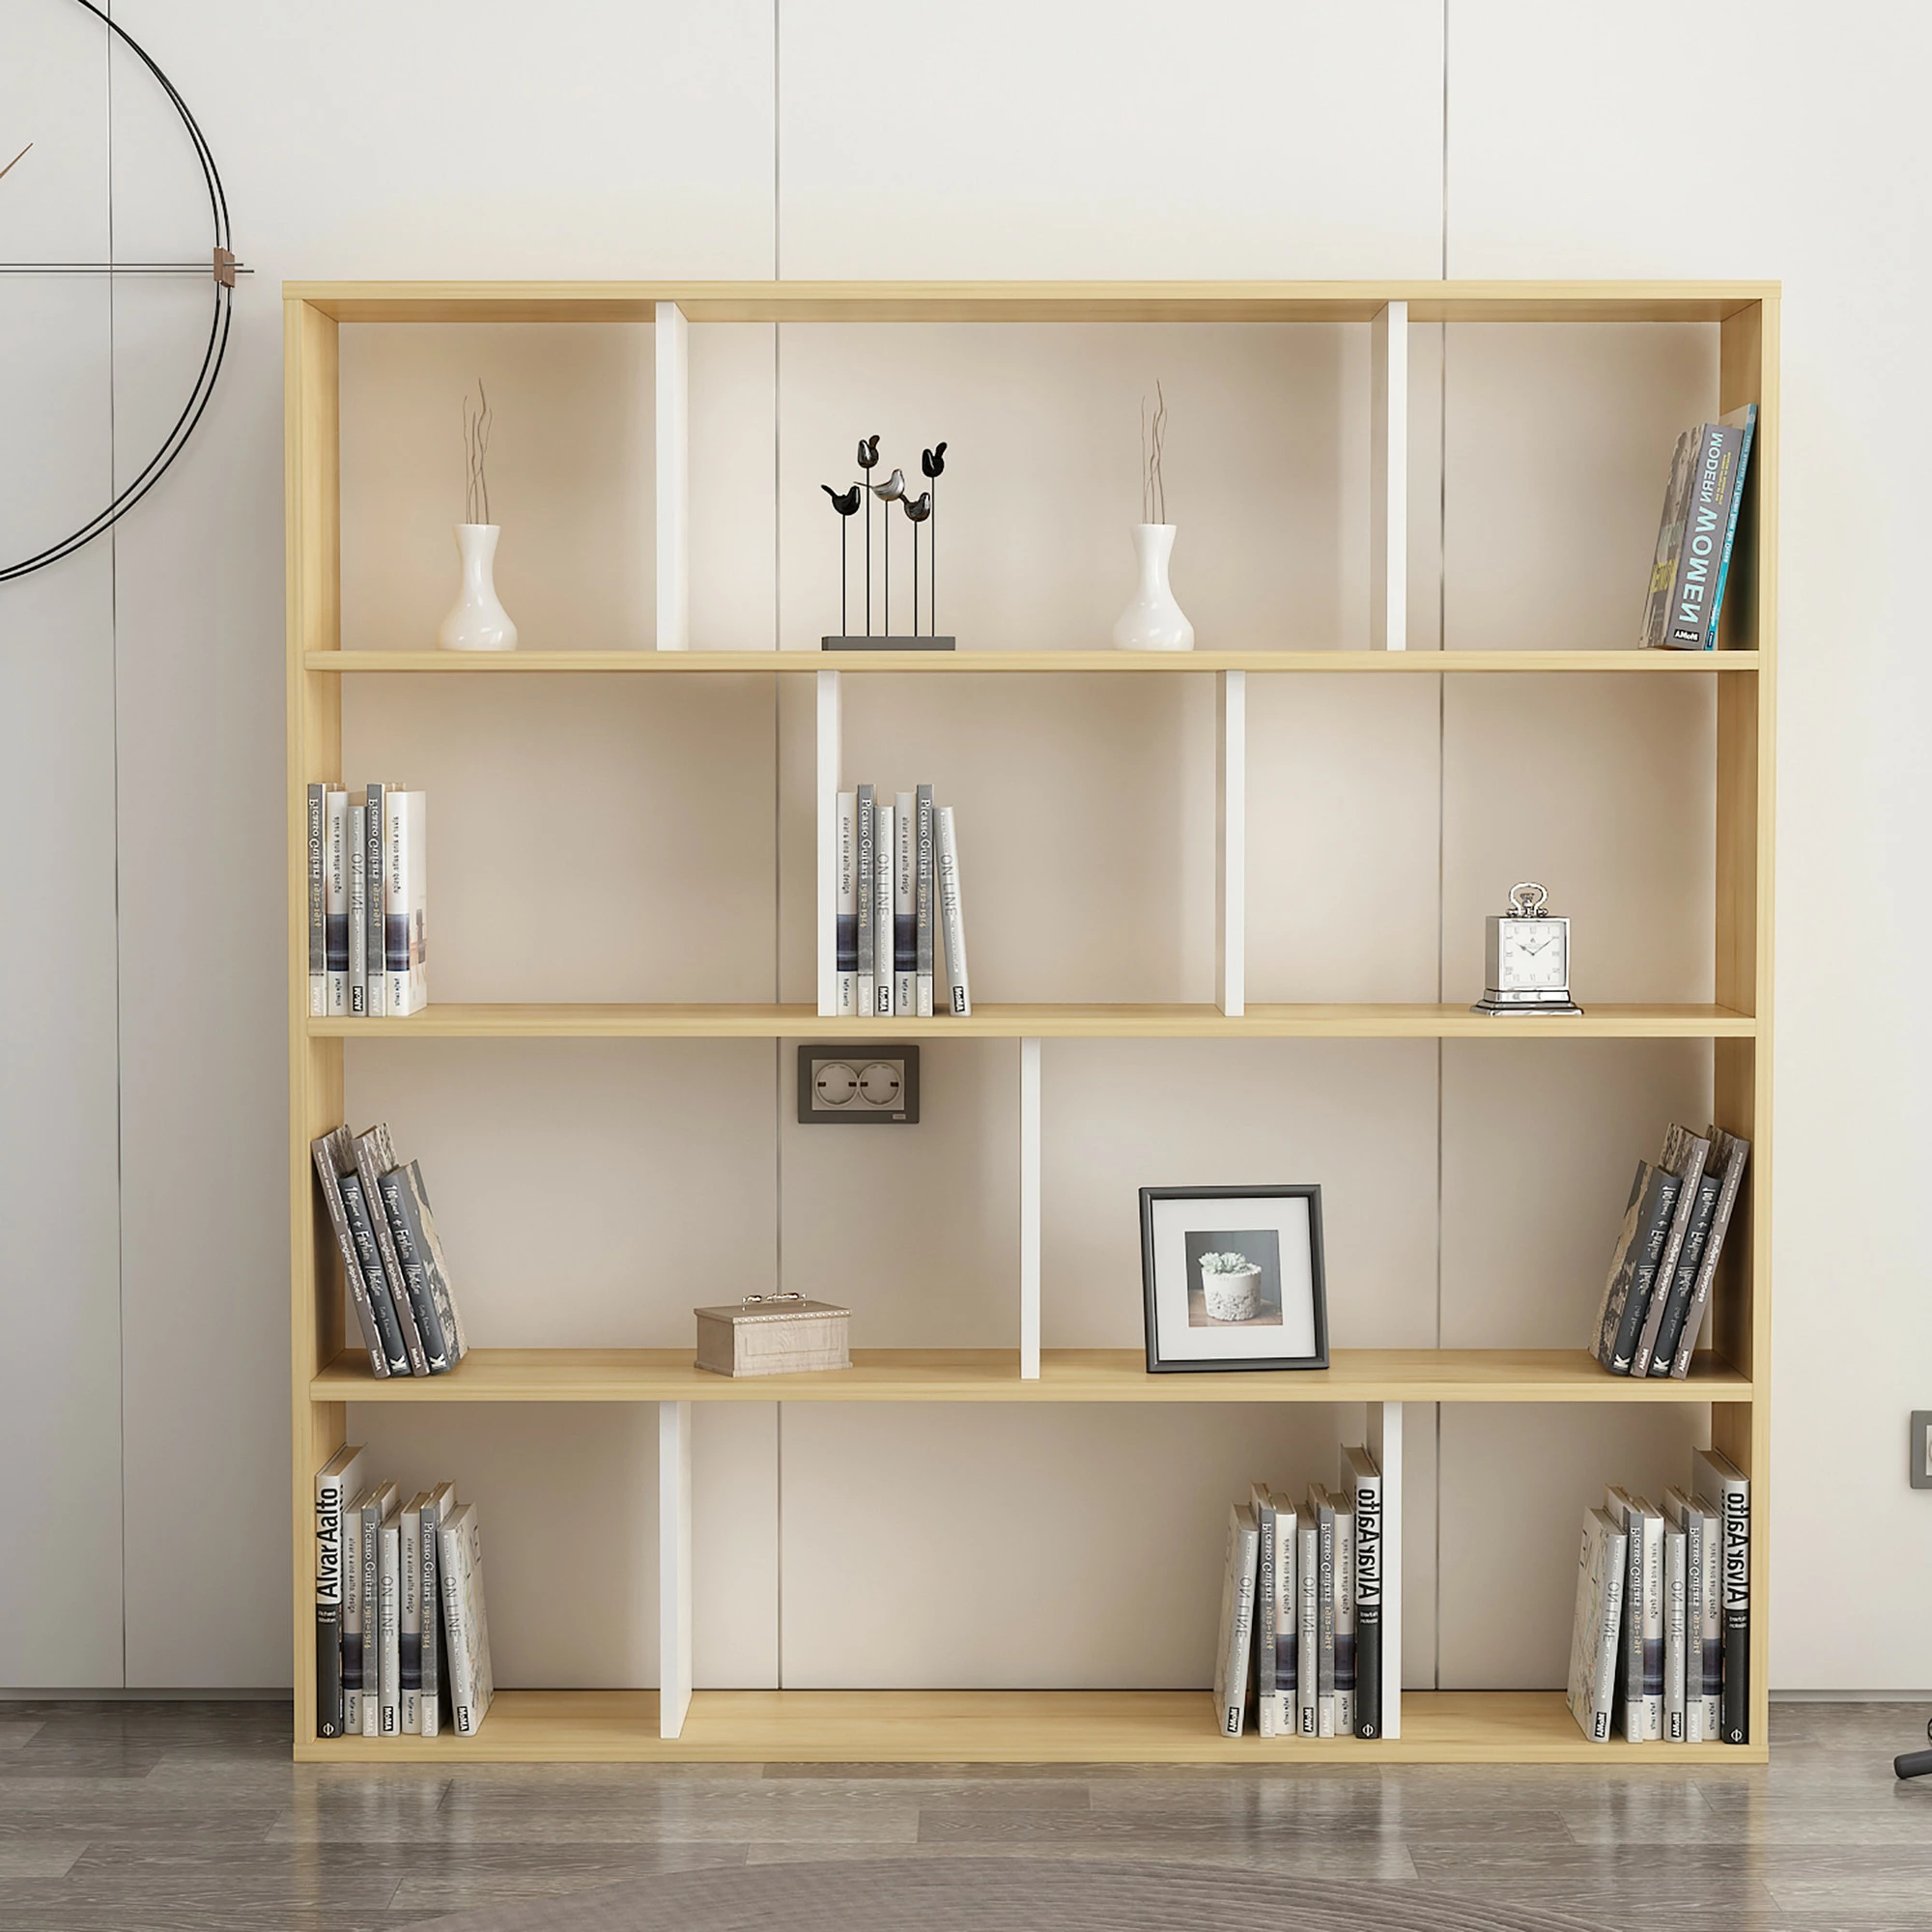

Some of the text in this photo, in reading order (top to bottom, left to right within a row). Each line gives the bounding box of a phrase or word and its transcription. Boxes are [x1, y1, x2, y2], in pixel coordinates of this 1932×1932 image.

[862, 799, 872, 838] Picasso
[921, 799, 931, 838] Picasso
[861, 838, 872, 879] Guitars
[877, 854, 890, 875] ON
[920, 838, 931, 879] Guitars
[941, 855, 953, 875] ON
[877, 883, 889, 916] LINE
[944, 883, 957, 917] LINE
[879, 987, 889, 1010] MoMA
[955, 987, 965, 1011] MoMA
[365, 1522, 376, 1558] Picasso
[424, 1522, 434, 1558] Picasso
[365, 1561, 376, 1602] Guitars
[381, 1577, 393, 1597] ON
[423, 1561, 435, 1602] Guitars
[444, 1577, 456, 1598] ON
[382, 1605, 393, 1636] LINE
[446, 1605, 461, 1637] LINE
[384, 1708, 393, 1730] MoMA
[459, 1708, 469, 1731] MoMA
